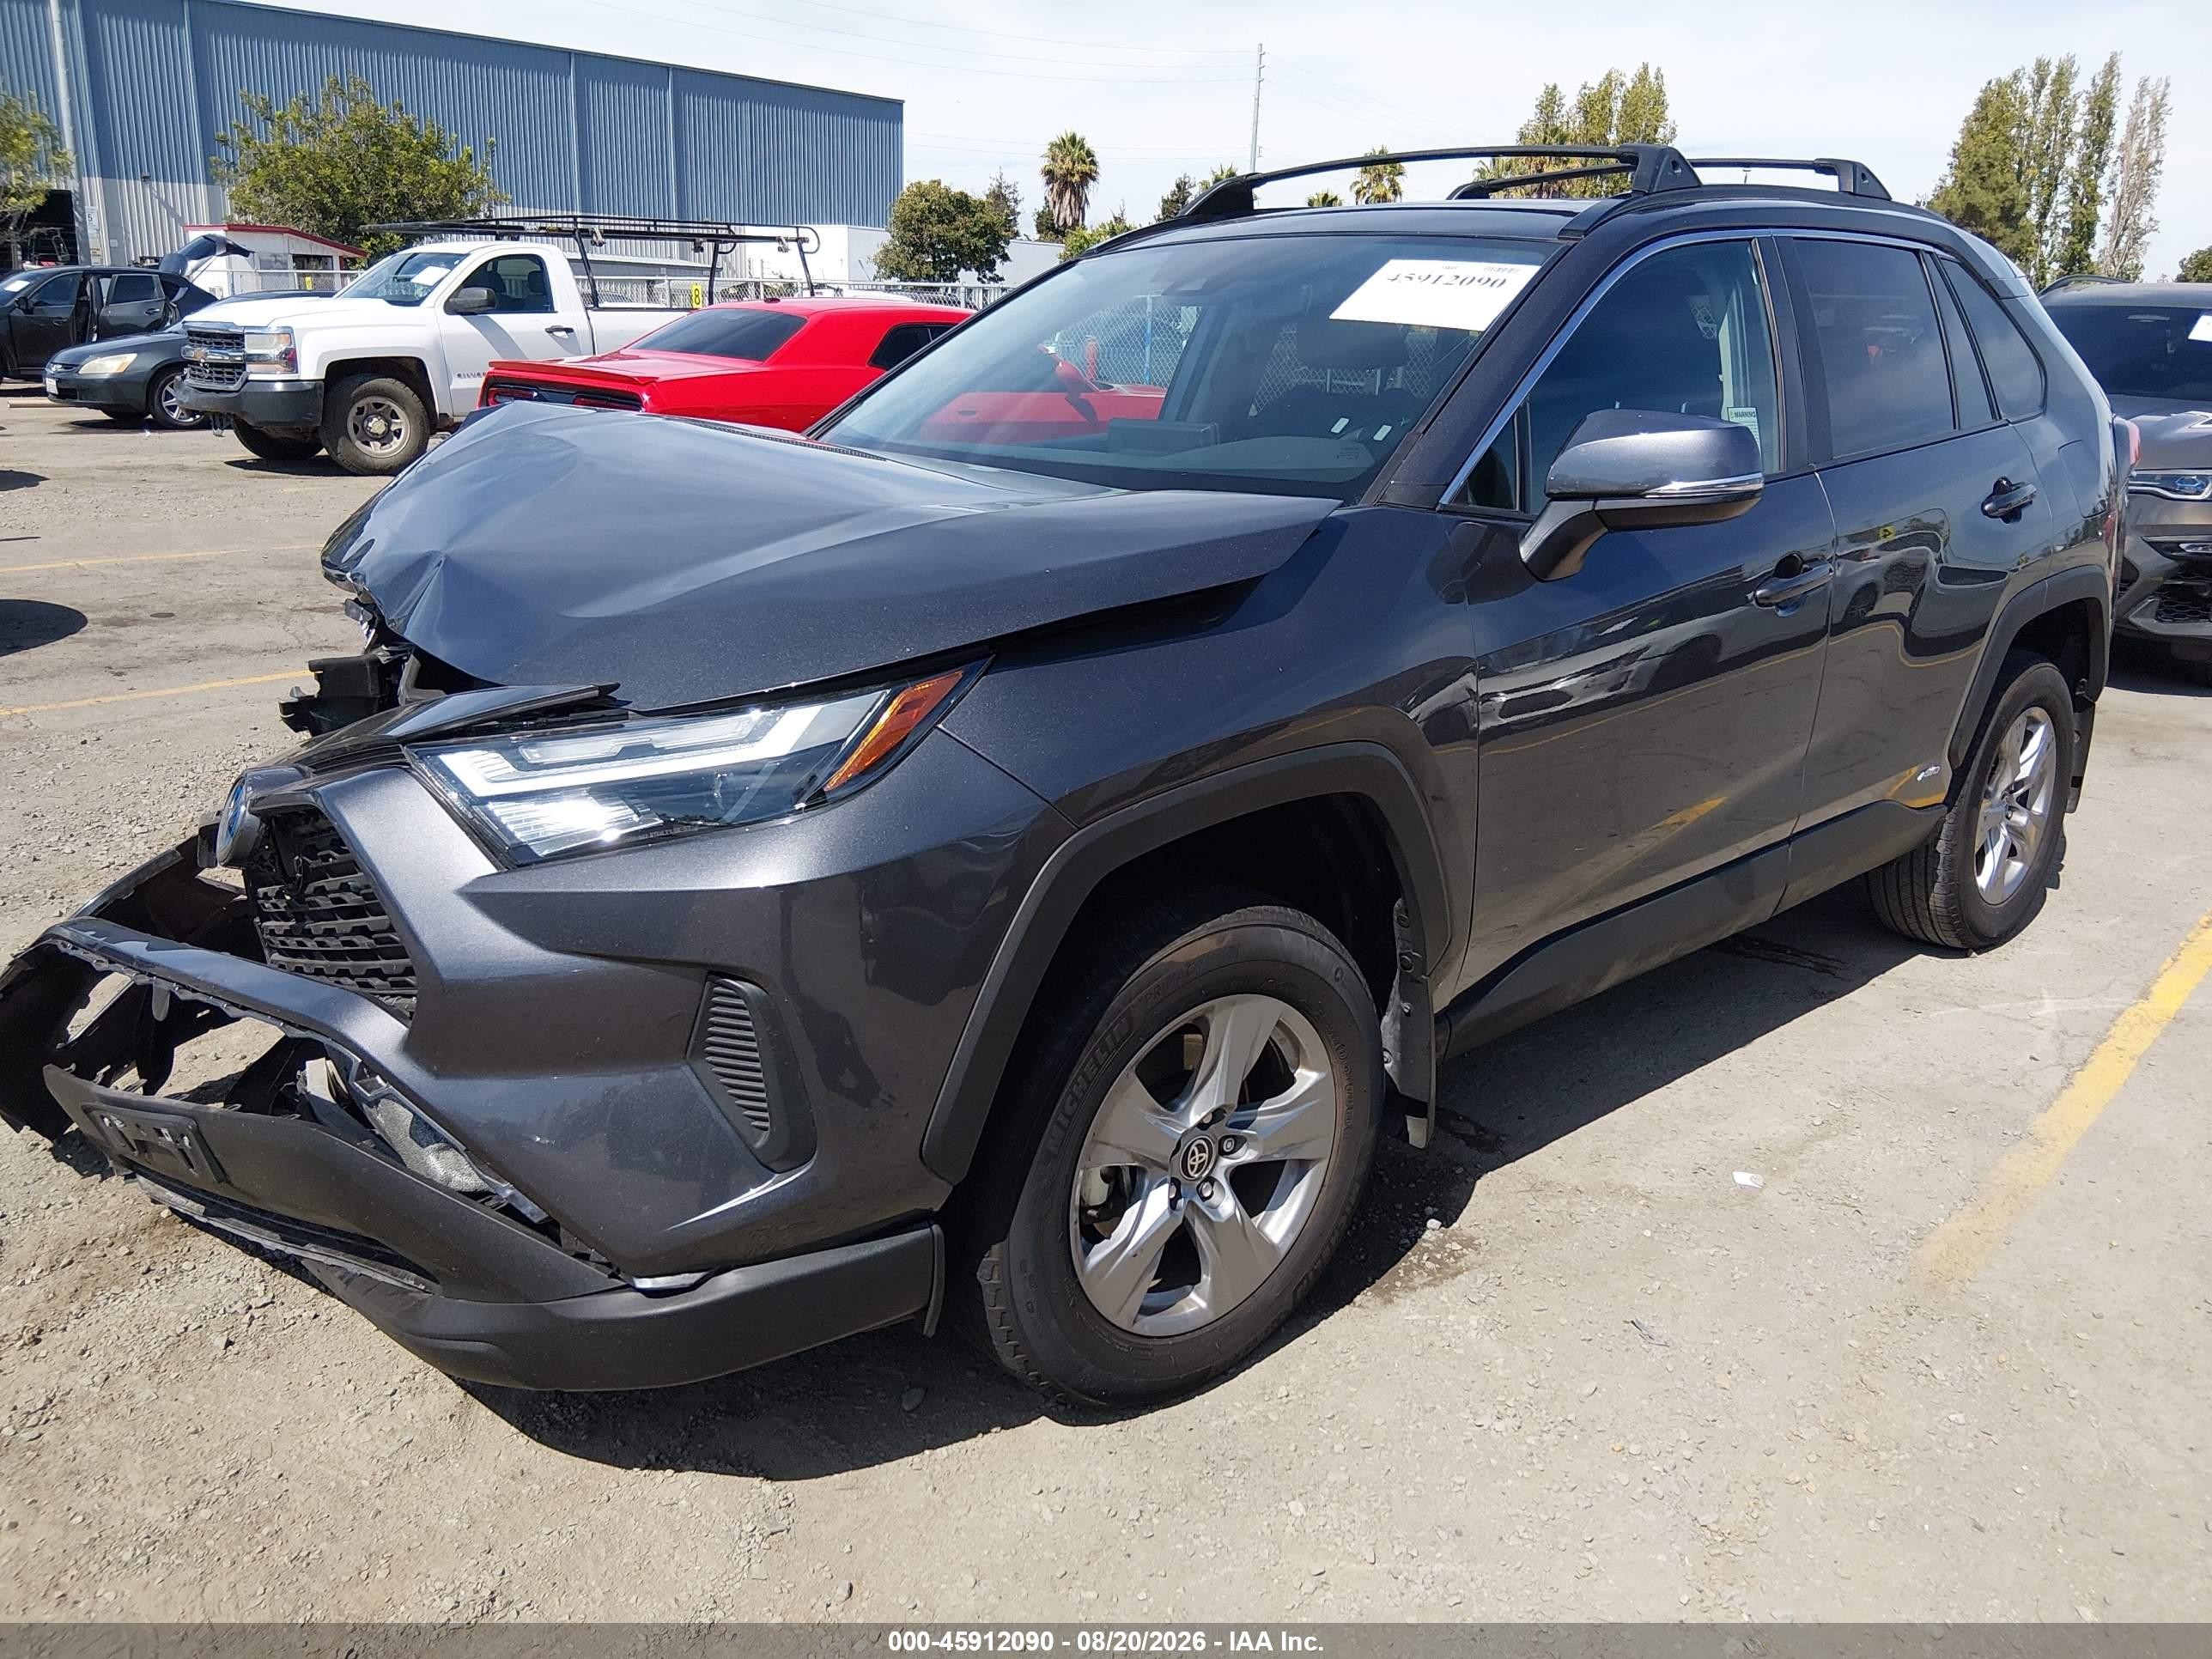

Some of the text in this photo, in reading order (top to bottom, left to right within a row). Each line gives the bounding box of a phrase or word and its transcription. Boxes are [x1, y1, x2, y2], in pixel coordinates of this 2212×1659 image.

[1387, 272, 1508, 289] 45912090
[694, 288, 701, 305] 8
[1046, 1017, 1128, 1156] MICHELIN
